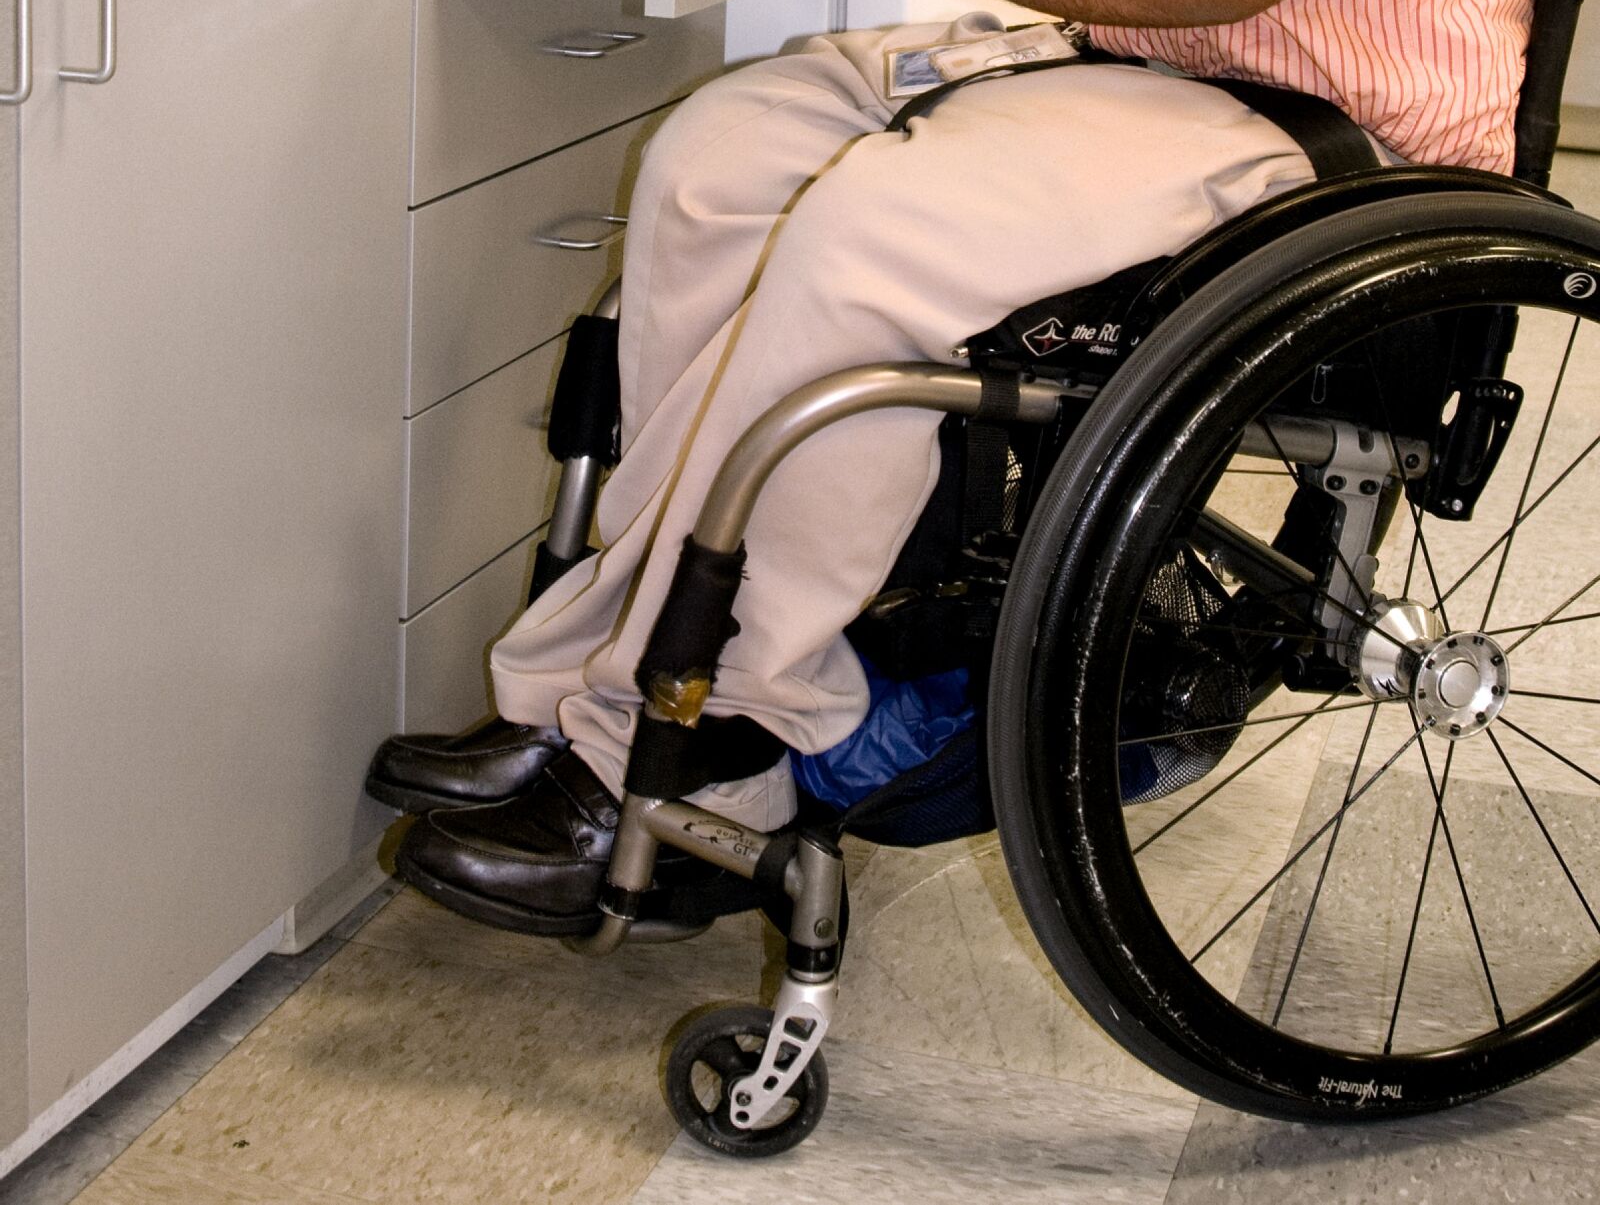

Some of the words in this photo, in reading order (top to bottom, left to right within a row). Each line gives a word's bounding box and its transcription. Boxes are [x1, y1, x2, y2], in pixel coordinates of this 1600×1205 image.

[1071, 324, 1097, 340] the
[733, 842, 751, 856] GT
[1318, 1076, 1379, 1099] Natural-Fit
[1382, 1084, 1402, 1098] The
